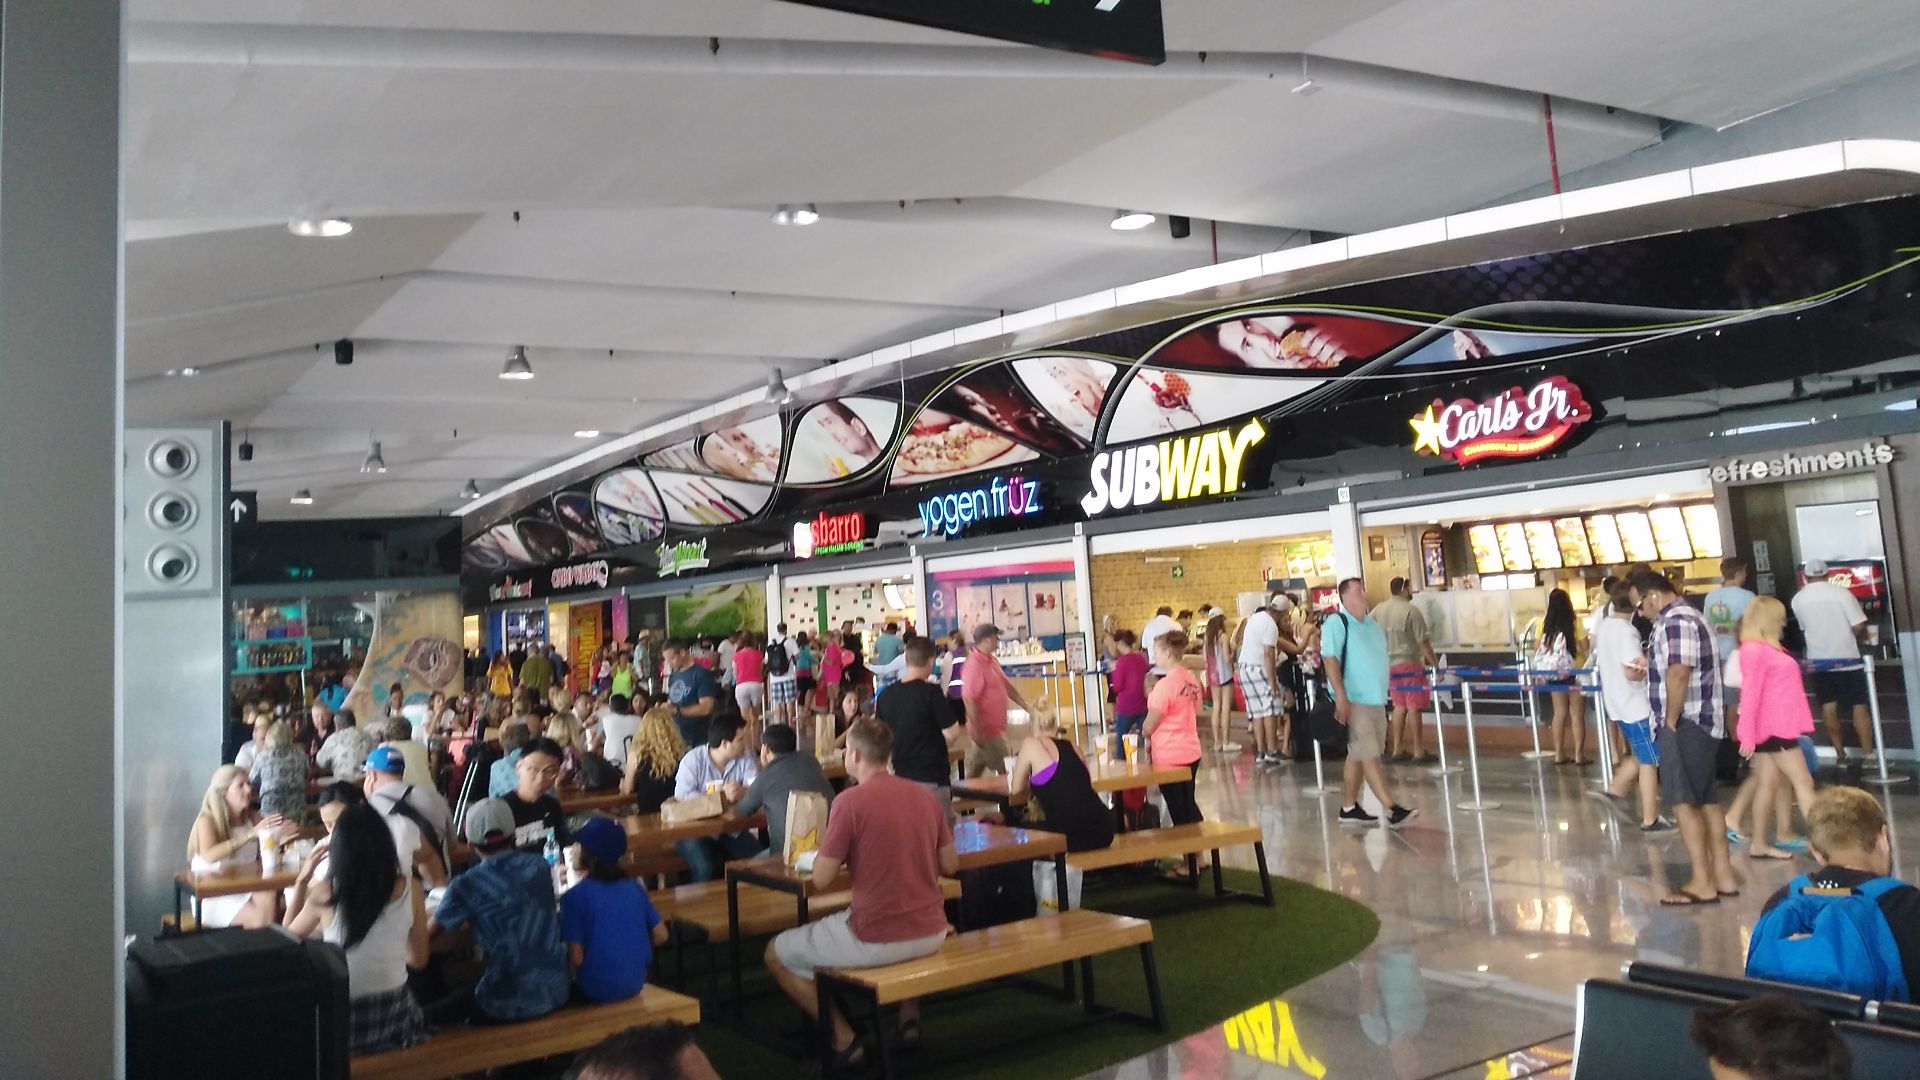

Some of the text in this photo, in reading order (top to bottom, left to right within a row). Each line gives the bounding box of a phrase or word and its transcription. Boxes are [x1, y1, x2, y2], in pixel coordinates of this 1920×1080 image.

[1439, 381, 1579, 448] Carl's Jr.
[1080, 416, 1266, 518] SUBWAY
[810, 511, 861, 547] sbarro
[918, 476, 1039, 538] yogen früz
